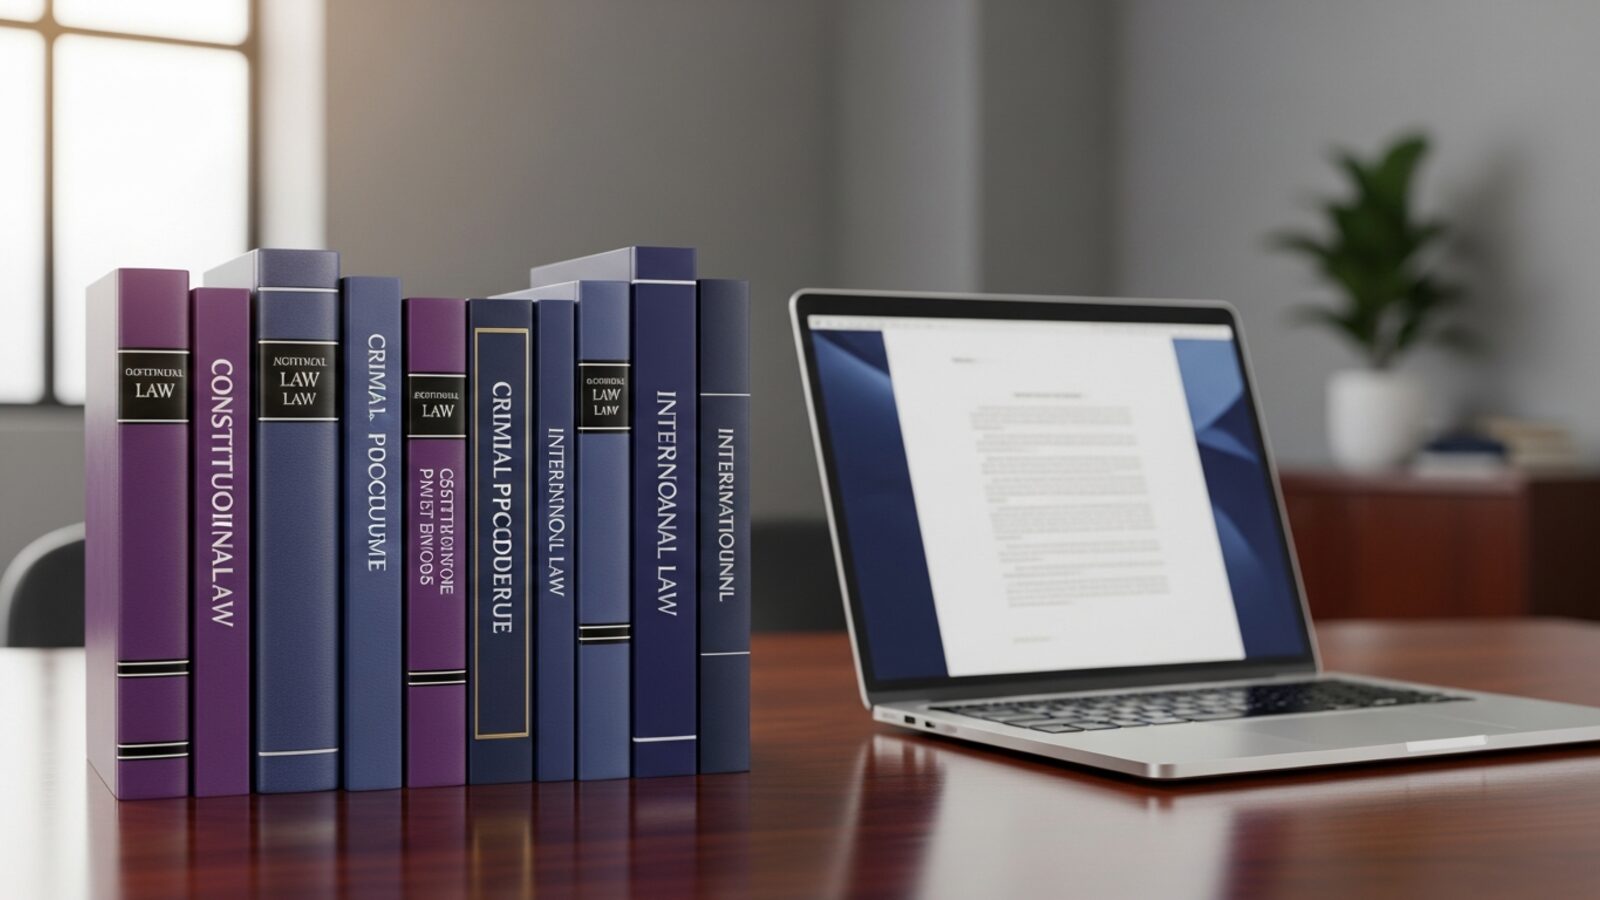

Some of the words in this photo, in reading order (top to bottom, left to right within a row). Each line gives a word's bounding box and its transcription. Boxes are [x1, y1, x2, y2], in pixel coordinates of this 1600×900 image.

[280, 371, 320, 388] LAW
[135, 383, 176, 399] LAW
[282, 392, 317, 406] LAW
[592, 388, 621, 401] LAW
[422, 404, 455, 418] LAW
[548, 556, 565, 597] LAW
[656, 565, 678, 616] LAW
